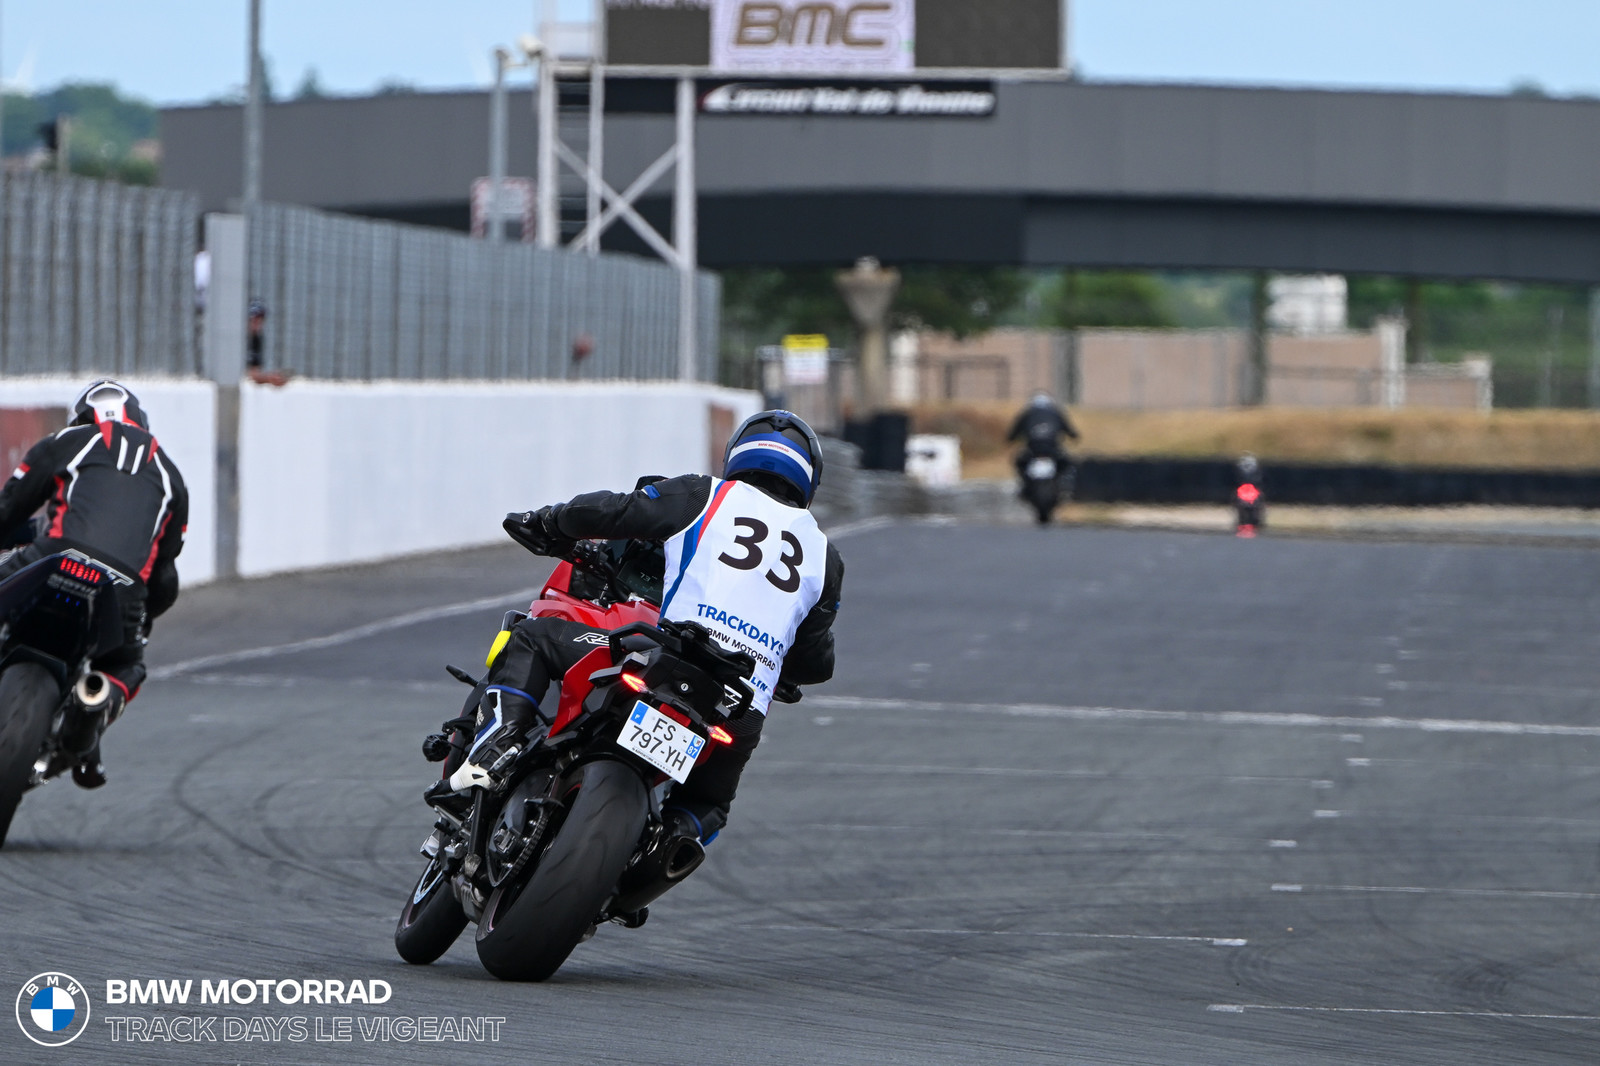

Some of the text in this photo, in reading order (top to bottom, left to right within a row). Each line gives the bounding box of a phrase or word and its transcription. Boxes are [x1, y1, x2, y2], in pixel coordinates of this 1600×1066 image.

[734, 2, 891, 46] BMC
[717, 516, 804, 593] 33
[697, 603, 784, 656] TRACKDAYS
[731, 639, 776, 671] MOTORRAD
[630, 725, 687, 772] 797-YH
[687, 745, 698, 756] 87
